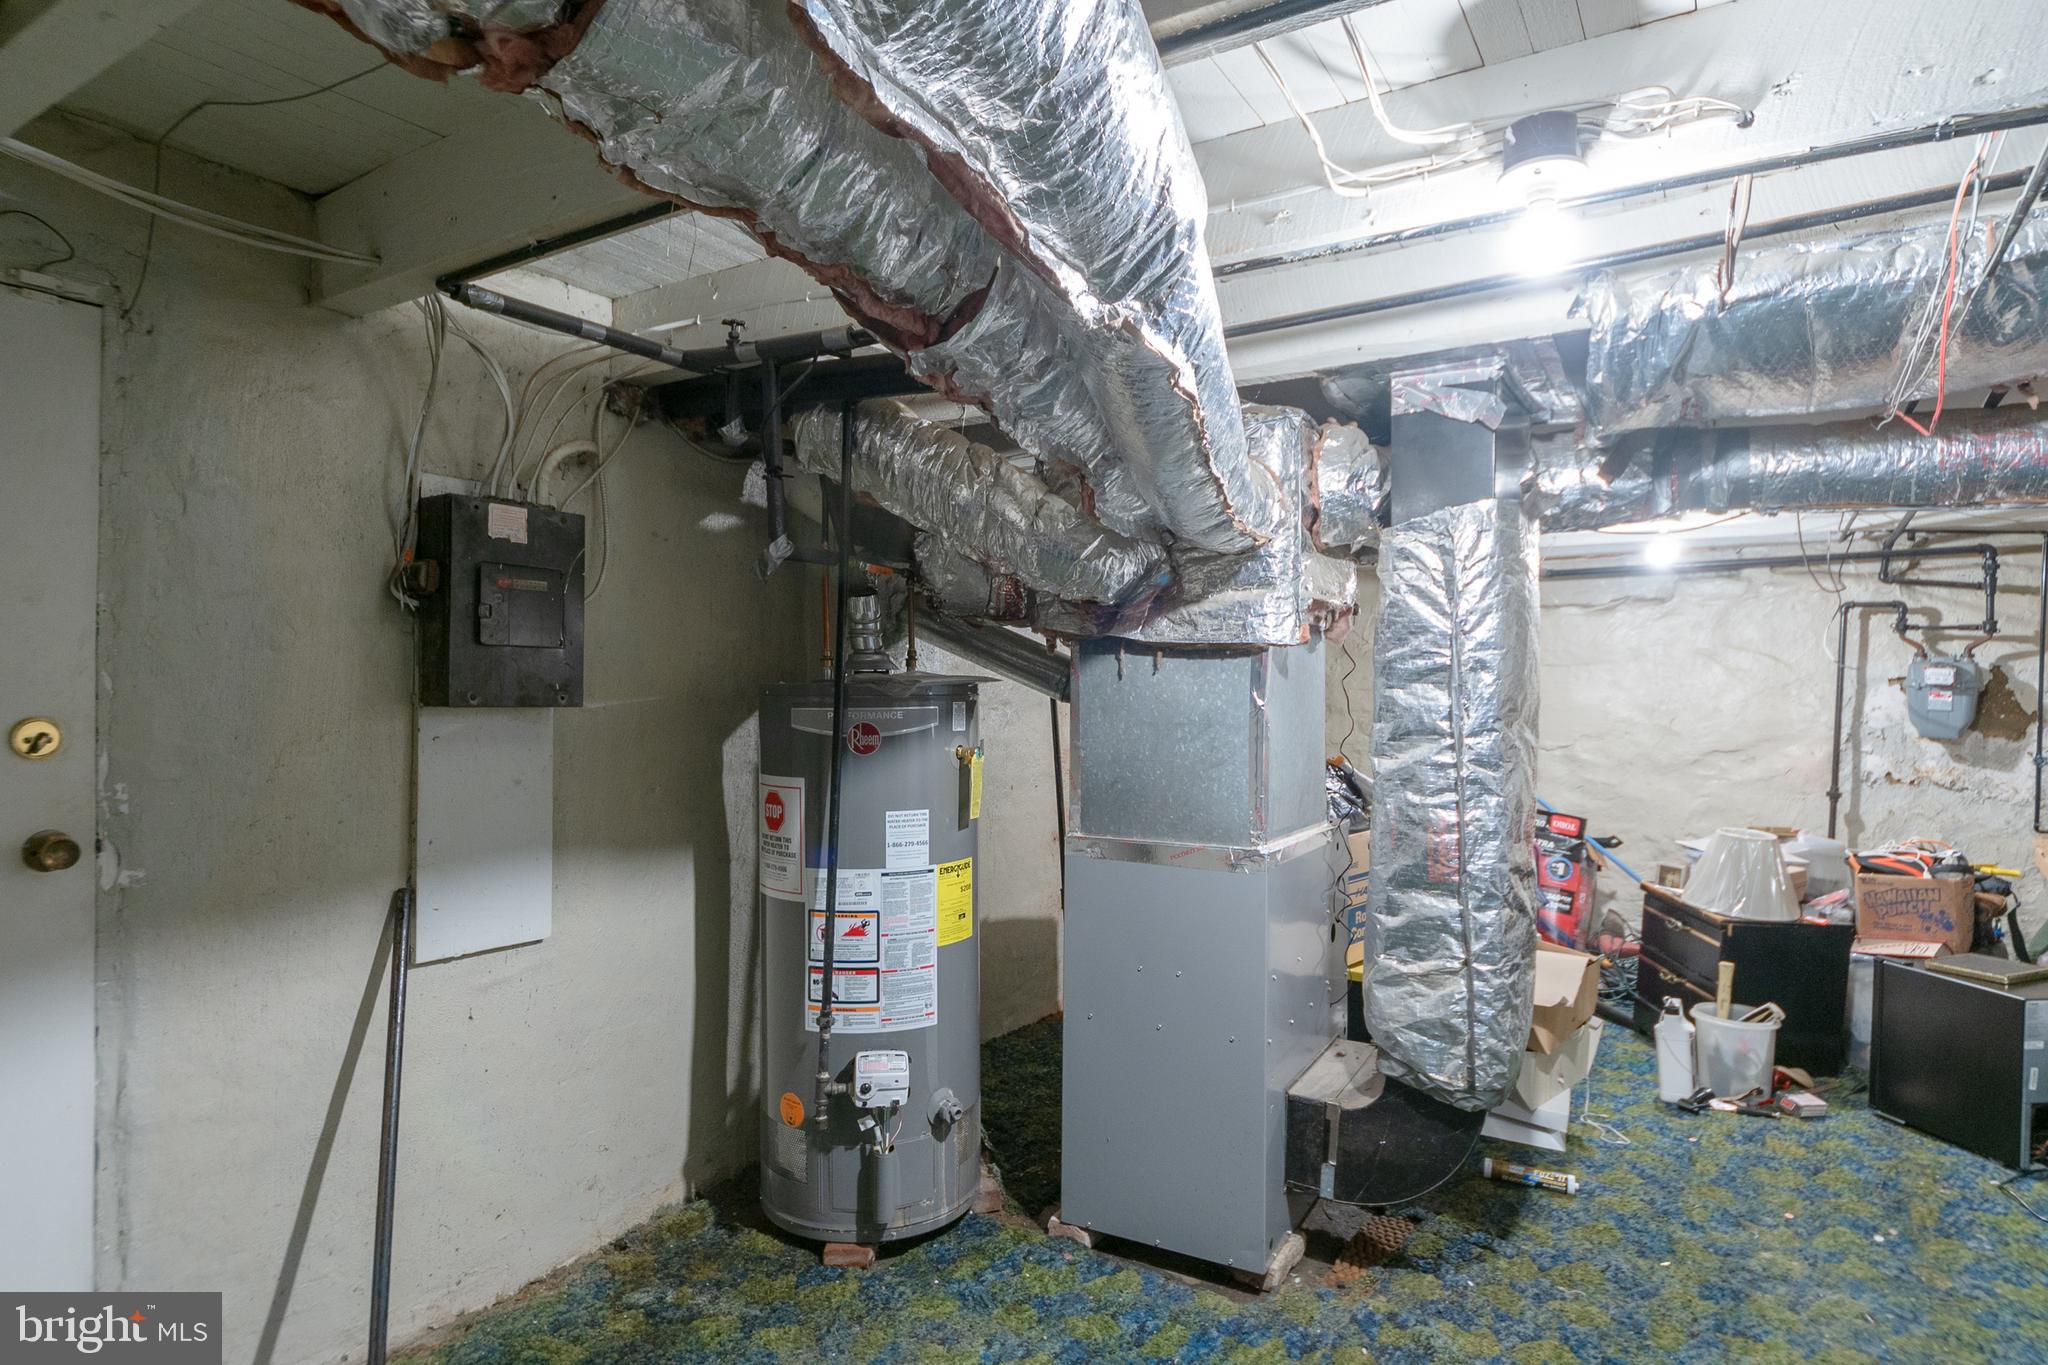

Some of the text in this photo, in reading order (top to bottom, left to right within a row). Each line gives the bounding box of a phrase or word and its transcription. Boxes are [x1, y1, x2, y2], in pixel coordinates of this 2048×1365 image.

[850, 723, 881, 750] Rheem
[765, 803, 783, 819] STOP
[783, 836, 792, 844] THIS
[776, 850, 797, 859] PURCHASE
[1864, 888, 1941, 908] HAWAIIAN
[1876, 899, 1933, 920] PUNCH
